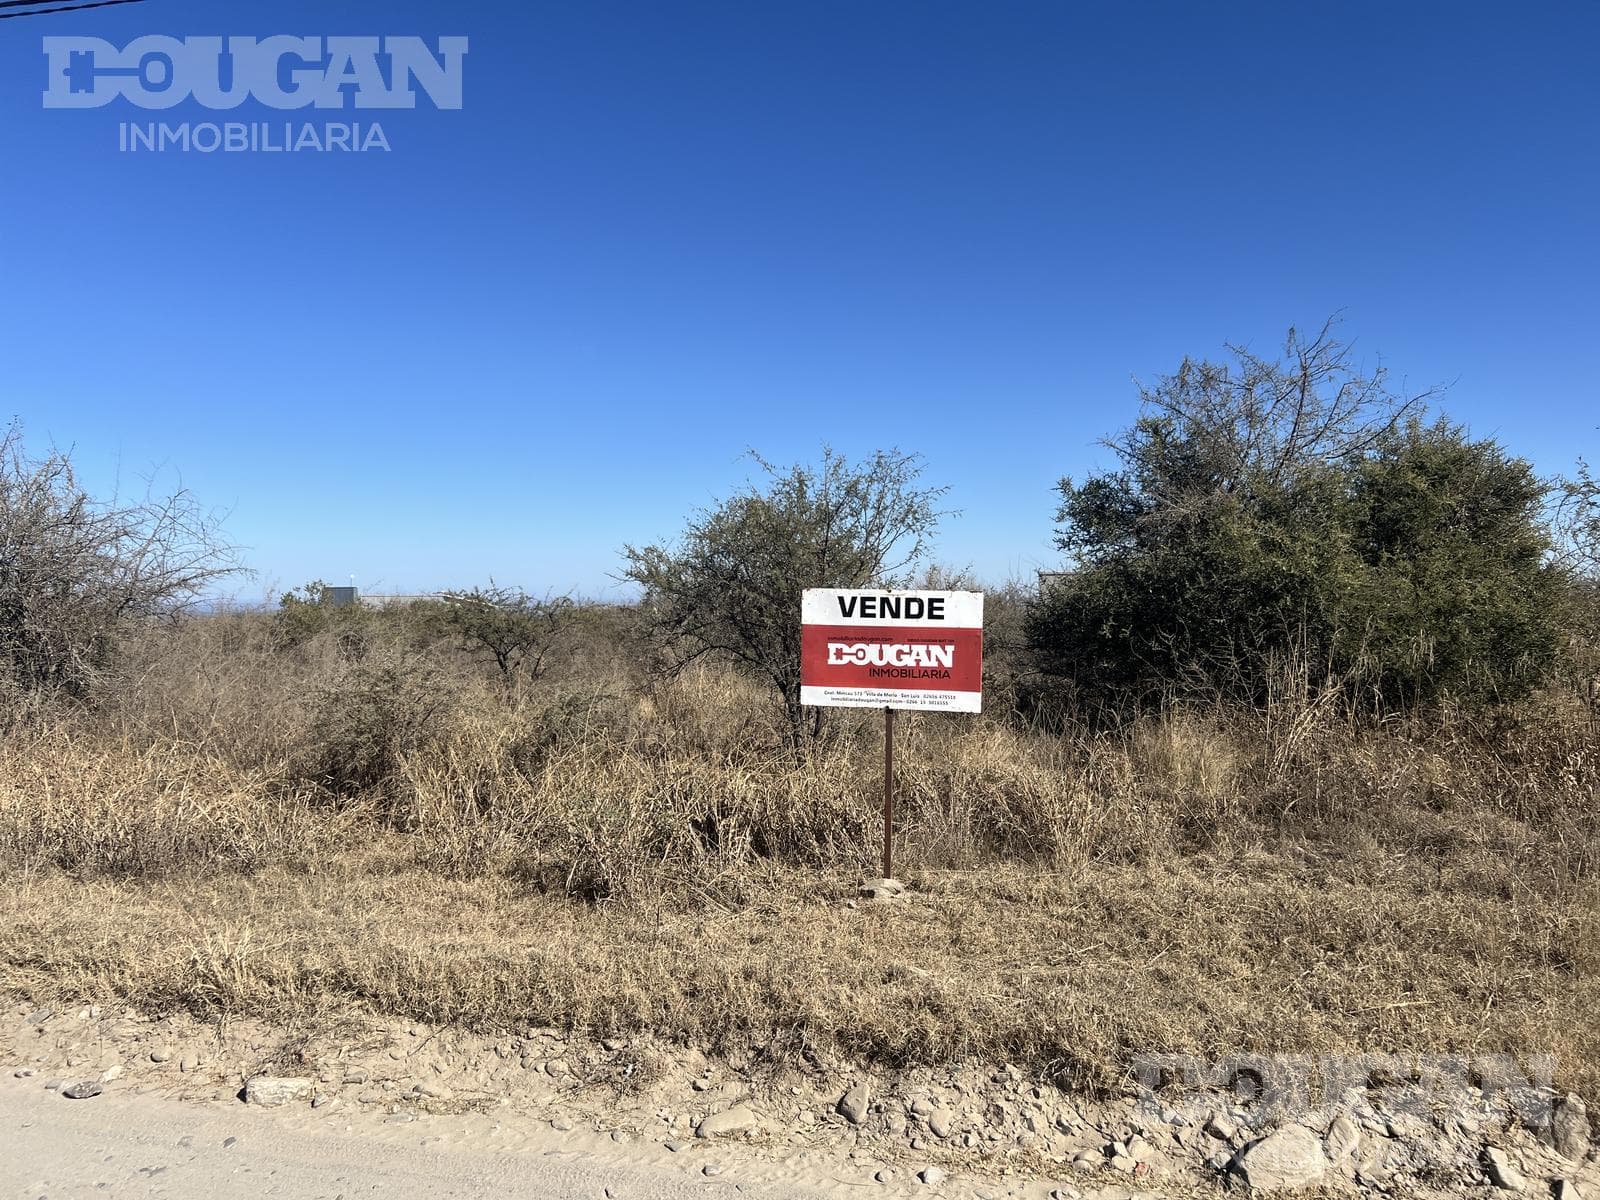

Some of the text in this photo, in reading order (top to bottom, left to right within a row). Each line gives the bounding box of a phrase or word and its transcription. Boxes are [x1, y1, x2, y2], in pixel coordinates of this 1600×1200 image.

[837, 596, 945, 620] VENDE
[827, 642, 955, 668] DOUGAN
[868, 668, 951, 679] INMOBILIARIA
